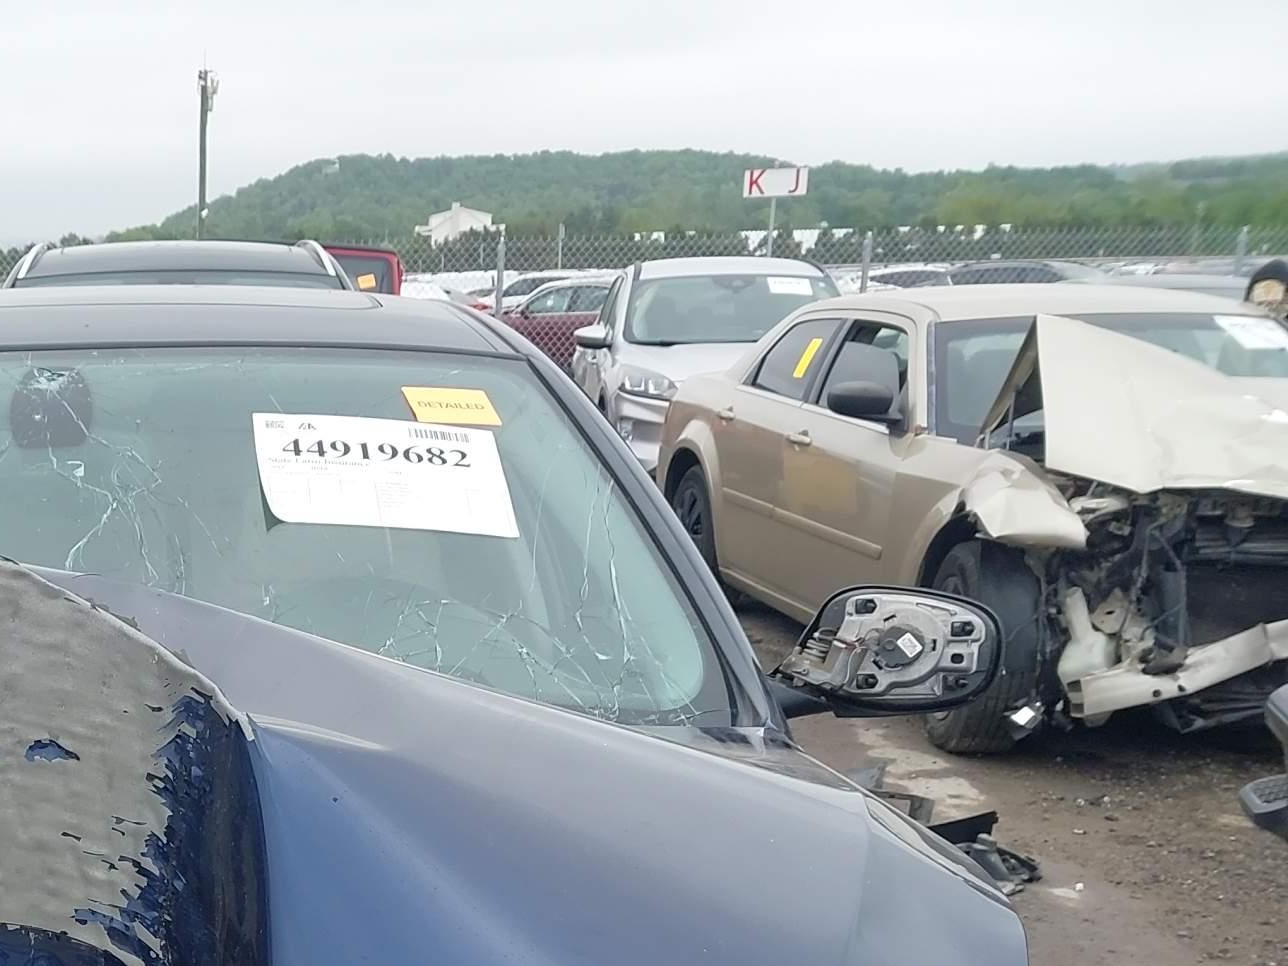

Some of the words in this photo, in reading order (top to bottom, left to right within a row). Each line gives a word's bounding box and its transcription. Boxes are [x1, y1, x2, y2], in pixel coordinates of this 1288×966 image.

[748, 169, 767, 195] K
[788, 168, 801, 194] J
[417, 401, 485, 411] DETAILED
[282, 438, 472, 468] 44919682
